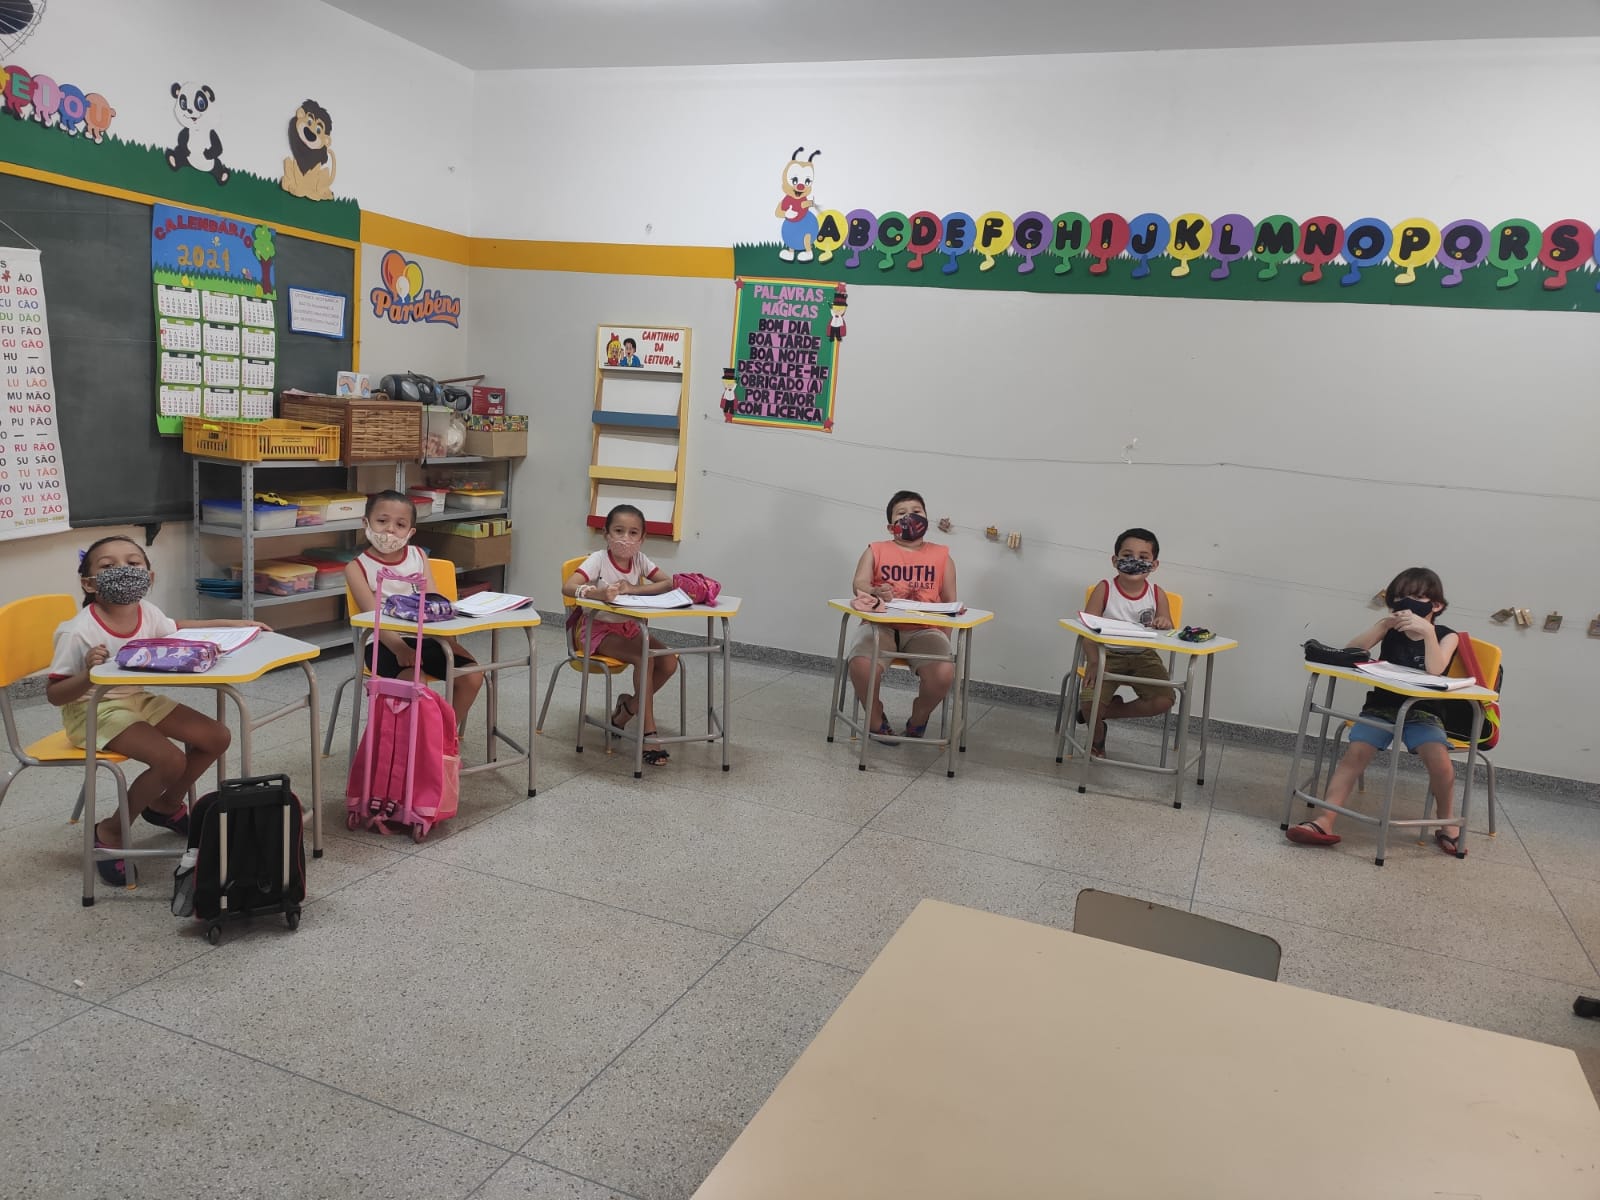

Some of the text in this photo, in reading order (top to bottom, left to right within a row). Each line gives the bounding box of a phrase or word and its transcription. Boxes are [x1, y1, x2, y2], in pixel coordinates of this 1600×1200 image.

[817, 215, 1580, 263] A B C D E F G H I J K L M N O P Q R S
[176, 244, 231, 272] 2021
[754, 285, 824, 302] PALAVRAS
[18, 300, 39, 310] CÃO
[762, 300, 818, 317] MÁGICAS
[0, 312, 13, 321] DU
[1, 325, 42, 336] FU FÃO
[758, 319, 811, 335] BOM DIA
[642, 331, 679, 341] CANTINHO
[2, 339, 16, 348] GU
[748, 333, 821, 350] BOA TARDE
[654, 343, 664, 352] DA
[3, 353, 18, 361] HU
[644, 355, 674, 365] LEITURA
[749, 347, 818, 365] BOA NOITE
[6, 365, 18, 375] JU
[738, 361, 828, 378] DESCULPE-ME
[7, 378, 20, 388] LU
[740, 373, 823, 394] OBRIGADO (A)
[7, 391, 51, 401] MU MÃO
[745, 388, 815, 407] POR FAVOR
[9, 404, 52, 414] NU NÃO
[738, 401, 822, 421] COM LICENÇA
[11, 417, 52, 427] PU PÃO
[14, 444, 28, 452] RU
[16, 456, 29, 466] SU
[35, 454, 56, 465] SÃO
[18, 468, 31, 478] TU
[19, 481, 33, 490] VU
[38, 480, 60, 489] VÃO
[21, 494, 34, 504] XU
[0, 509, 14, 519] ZO
[23, 507, 36, 516] ZU
[881, 565, 935, 581] SOUTH
